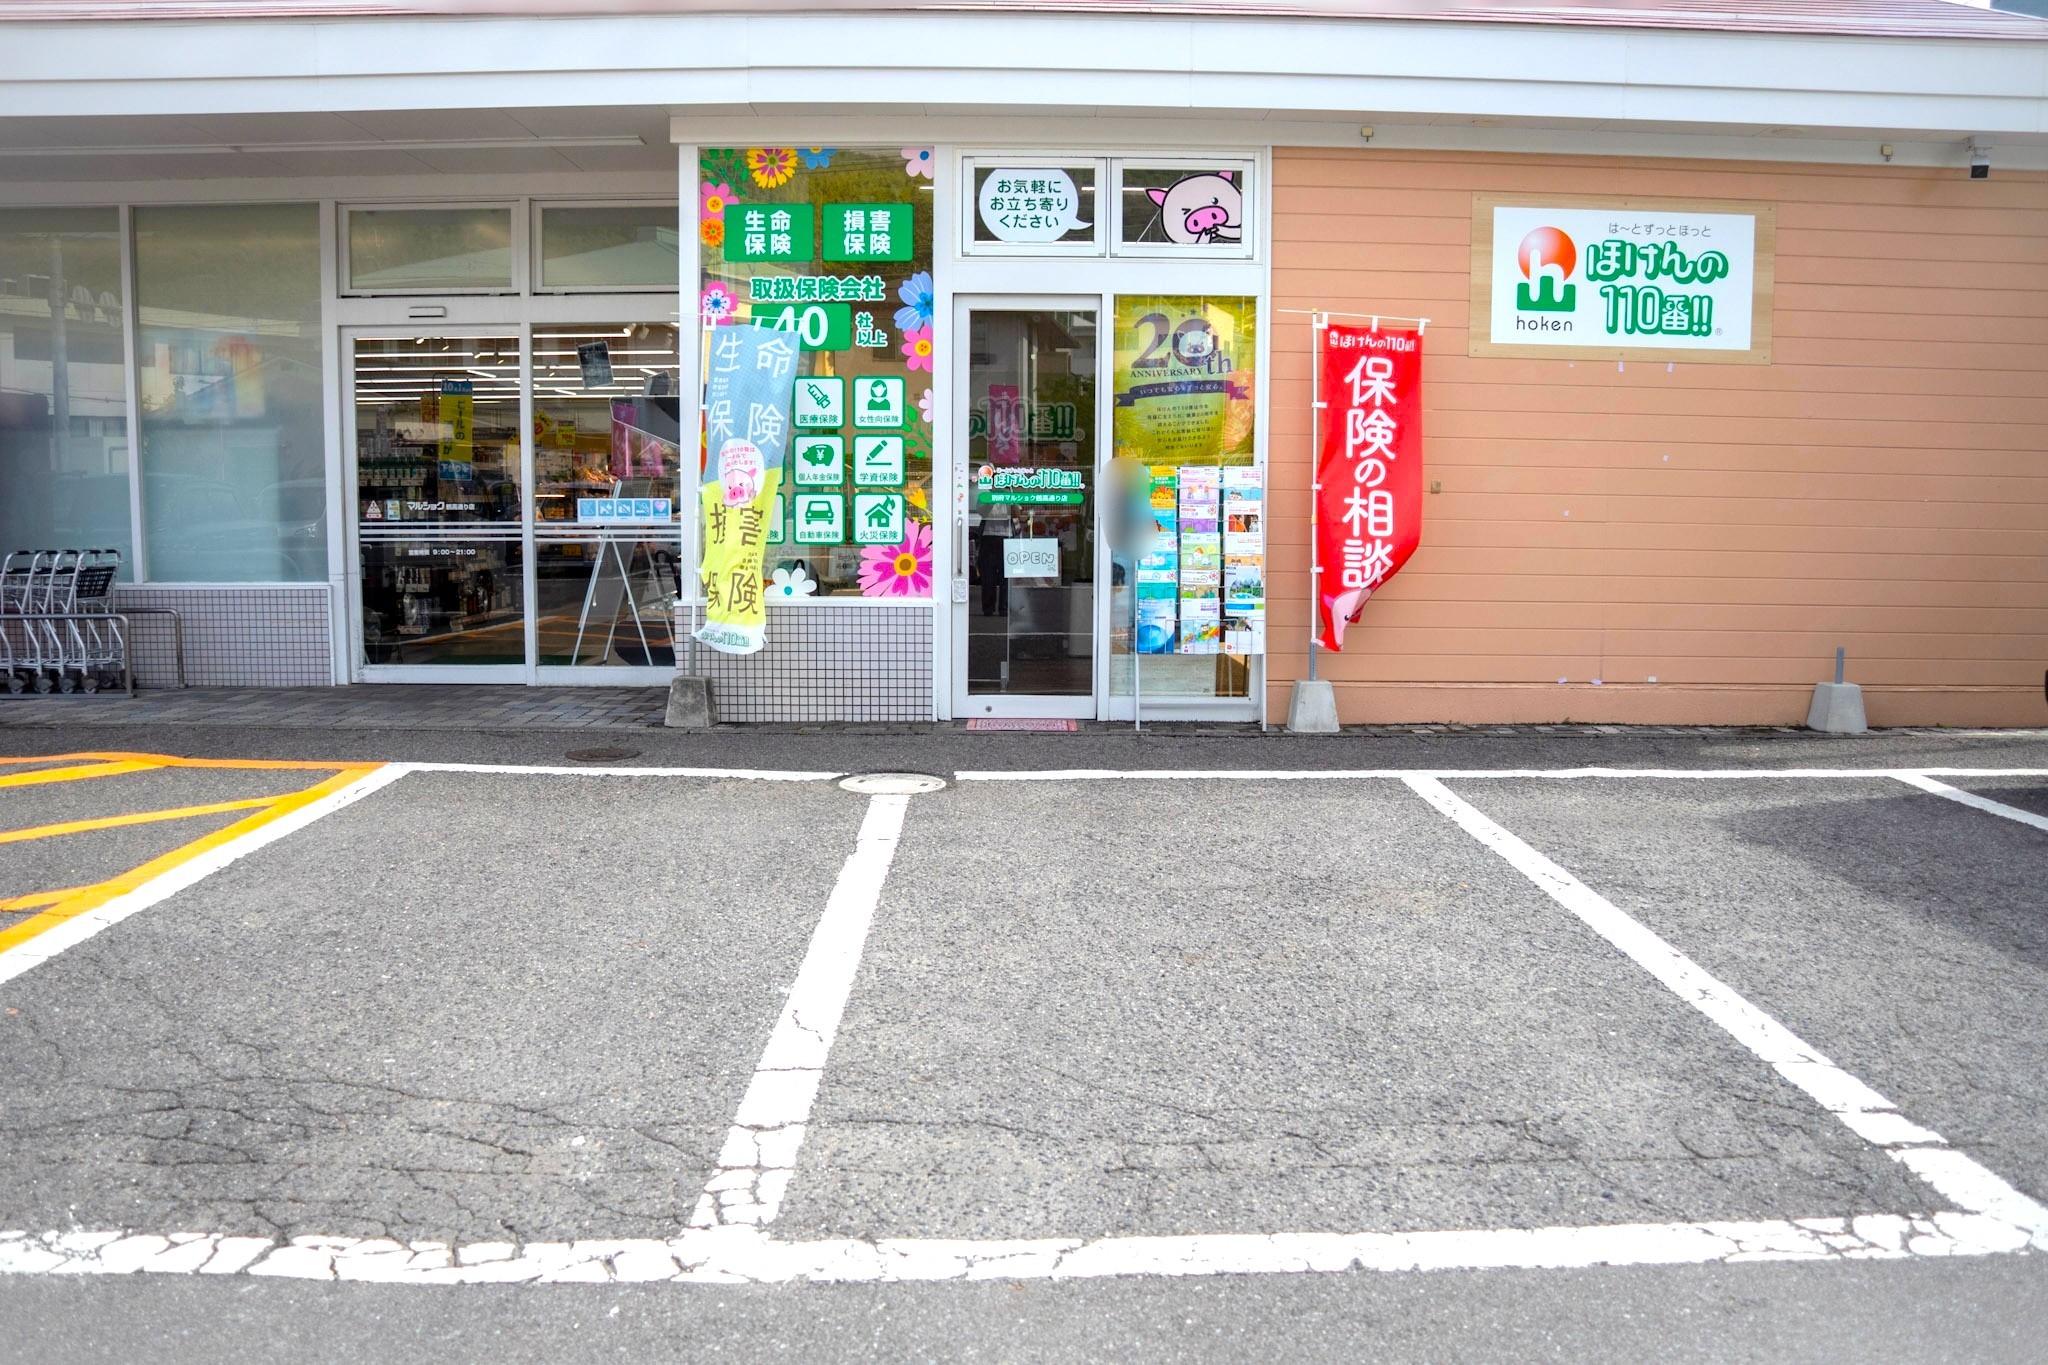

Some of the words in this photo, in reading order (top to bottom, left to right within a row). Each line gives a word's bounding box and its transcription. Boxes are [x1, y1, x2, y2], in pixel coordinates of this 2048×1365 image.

[997, 179, 1062, 194] お気軽に
[990, 196, 1069, 211] お立ち寄り
[744, 210, 792, 232] 生命
[843, 210, 892, 232] 損害
[999, 214, 1059, 228] ください
[744, 233, 792, 255] 保険
[843, 233, 892, 255] 保険
[1586, 239, 1729, 284] ほけんの
[751, 277, 886, 301] 取扱保険会社
[1600, 284, 1714, 337] 110番!!
[856, 312, 873, 329] 社
[1516, 316, 1573, 332] hoken
[856, 330, 888, 347] 以上
[715, 332, 793, 378] 生命
[1130, 368, 1203, 378] ANNIVERSARY
[707, 400, 785, 447] 保険
[799, 414, 839, 425] 医療保険
[858, 414, 899, 424] 女性向保険
[798, 472, 840, 482] 個人年金保険
[859, 472, 899, 482] 学資保険
[1342, 355, 1397, 588] 保険の相談
[406, 501, 445, 510] マルショク
[799, 530, 840, 540] 自動車保険
[859, 530, 899, 541] 火災保険
[1006, 550, 1055, 566] OPEN
